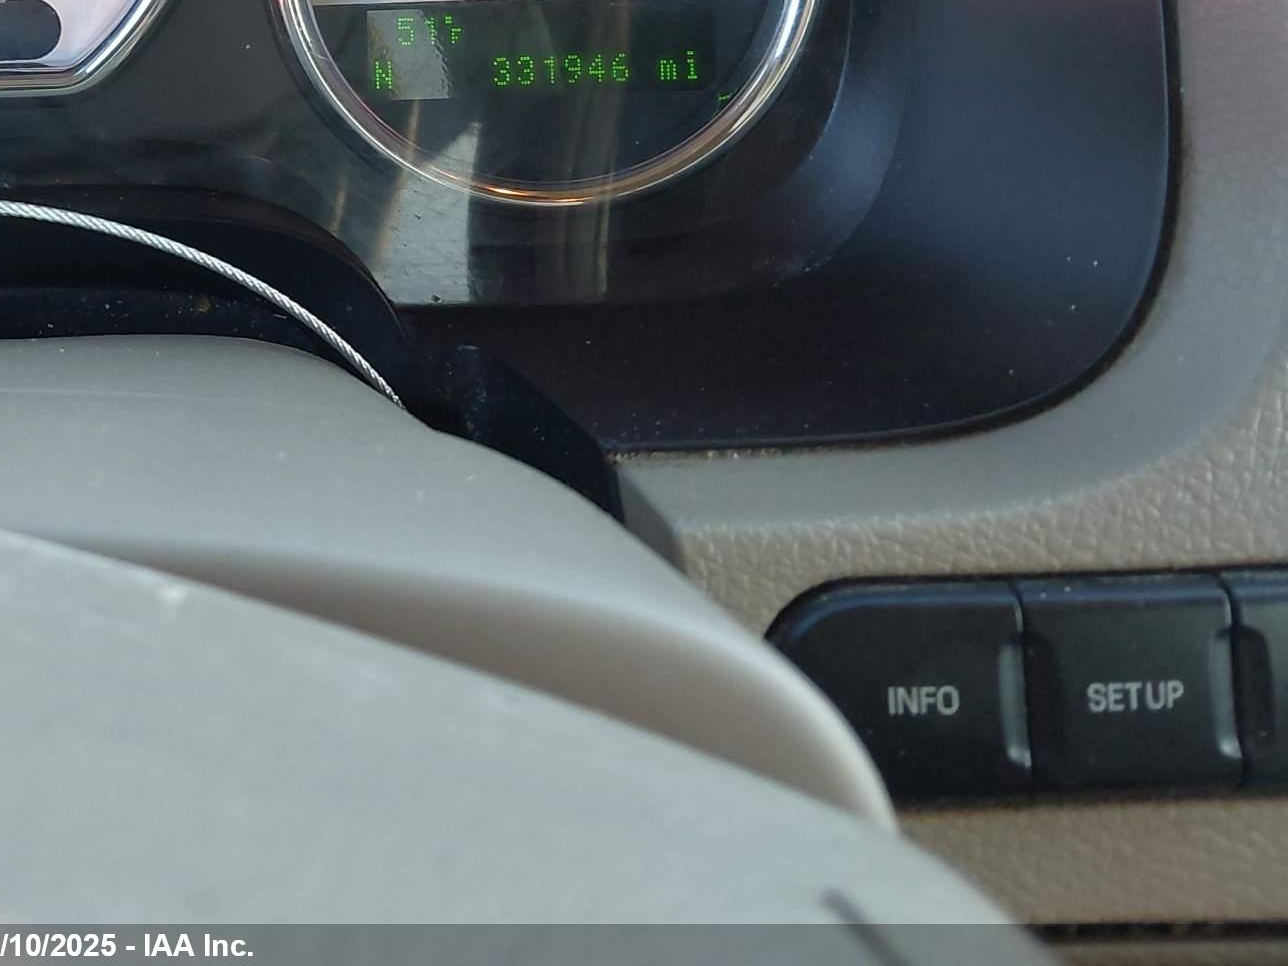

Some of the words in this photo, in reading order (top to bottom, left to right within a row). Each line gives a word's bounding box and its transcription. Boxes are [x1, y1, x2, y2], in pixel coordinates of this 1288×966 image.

[374, 61, 393, 90] N
[493, 52, 629, 86] 331946
[660, 50, 698, 81] mi
[887, 685, 960, 716] INFO
